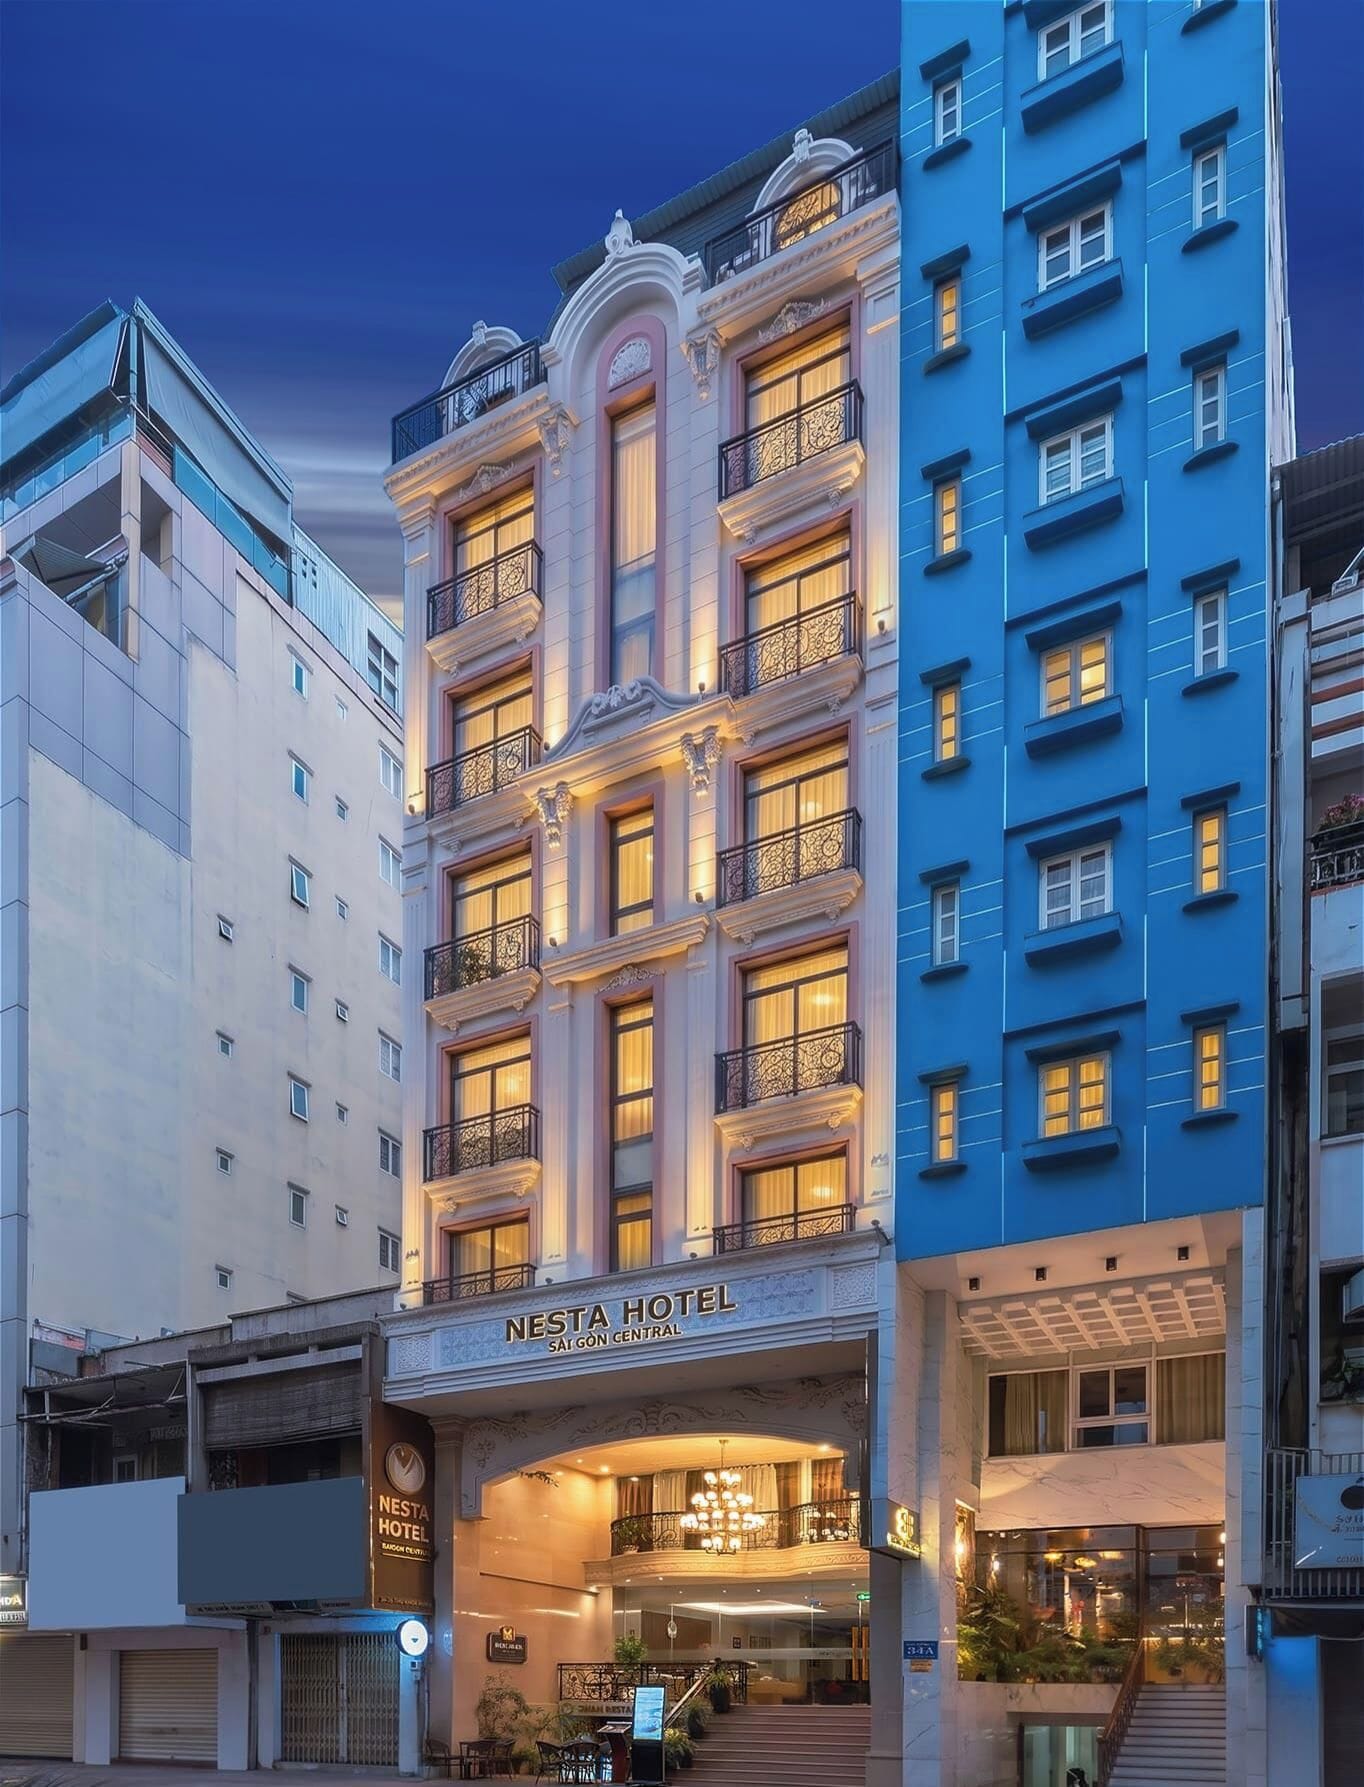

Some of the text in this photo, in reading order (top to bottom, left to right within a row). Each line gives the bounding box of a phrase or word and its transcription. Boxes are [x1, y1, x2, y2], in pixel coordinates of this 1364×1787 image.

[506, 1284, 737, 1343] NESTA HOTEL
[613, 1324, 683, 1344] CENTRAL
[379, 1495, 429, 1521] NESTA
[379, 1517, 429, 1543] HOTEL
